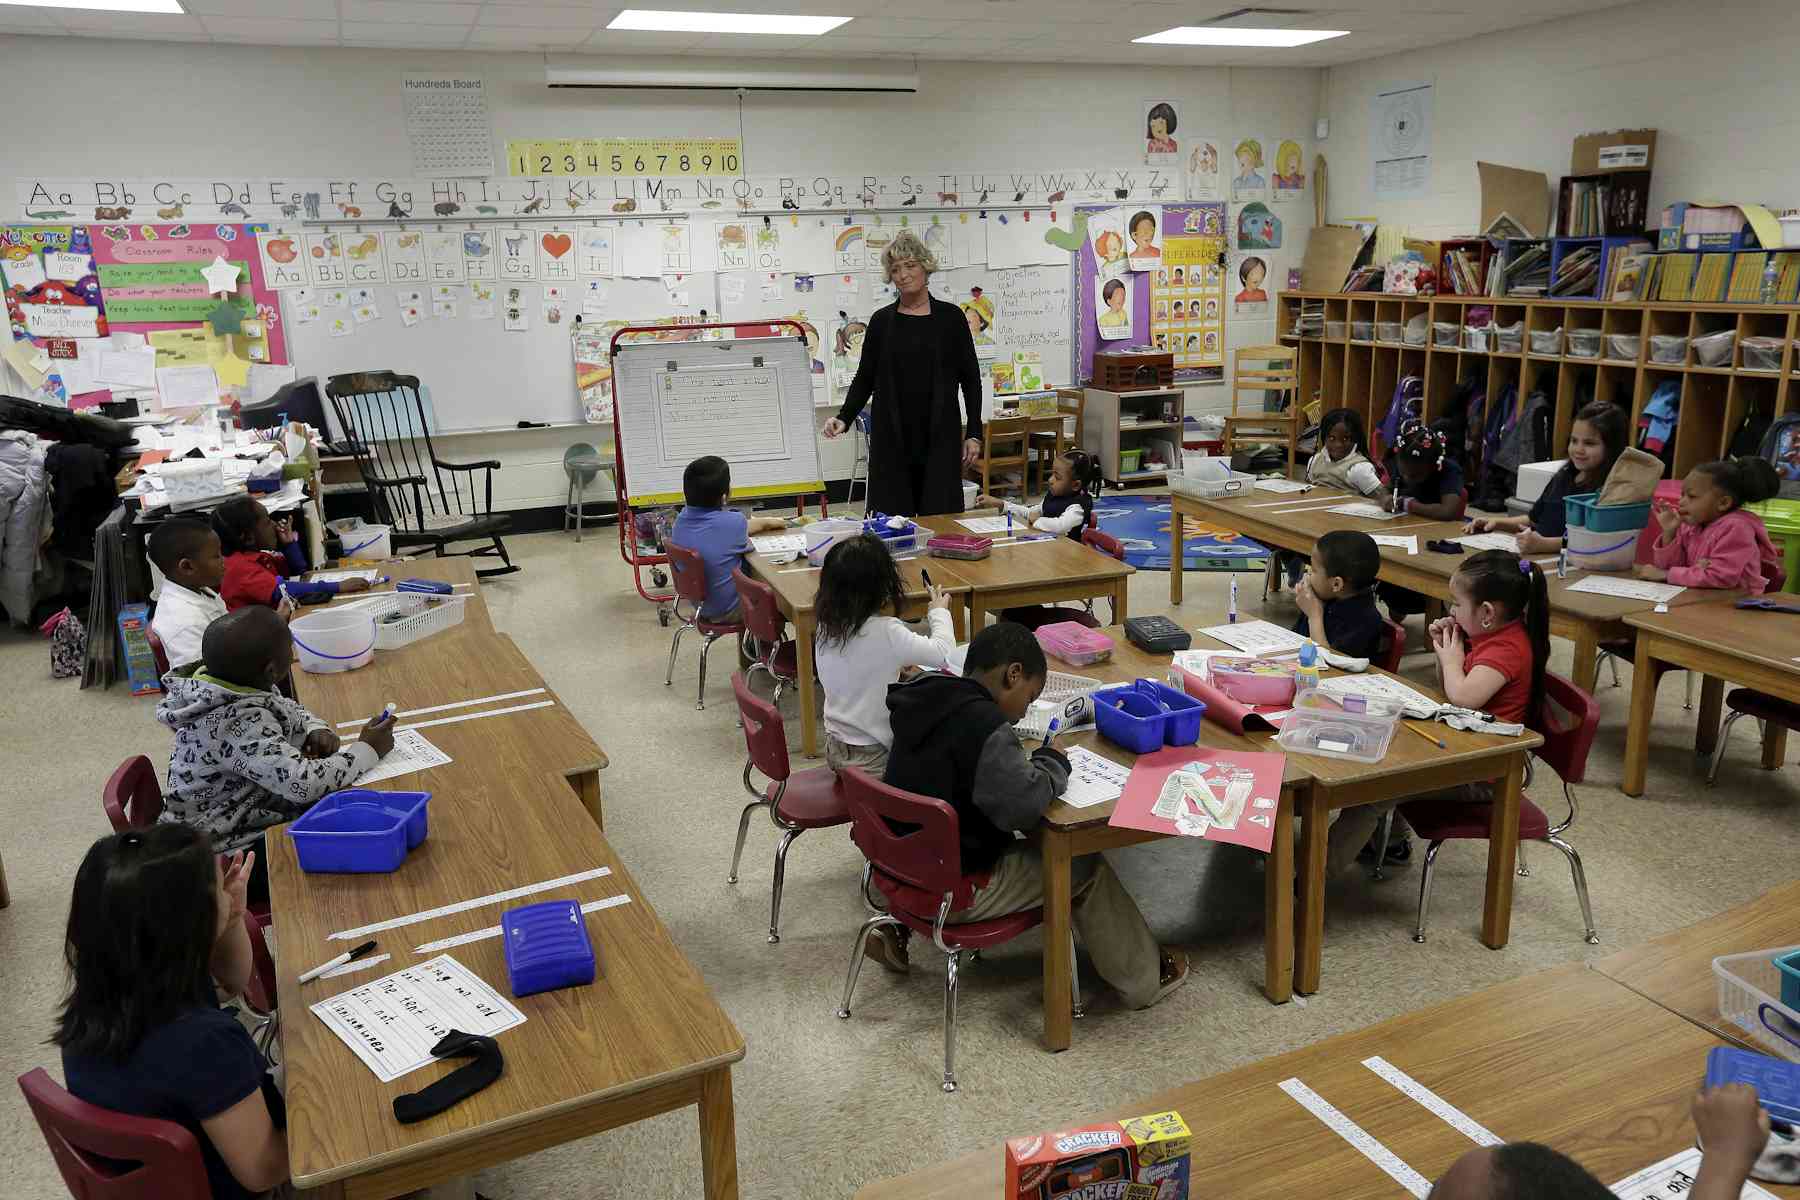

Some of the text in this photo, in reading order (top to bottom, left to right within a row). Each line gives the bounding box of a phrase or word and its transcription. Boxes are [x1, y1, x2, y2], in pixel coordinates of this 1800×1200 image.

[453, 79, 481, 89] Board
[519, 154, 738, 173] 1 2 3 4 5 6 7 8 9 10
[1055, 1131, 1120, 1152] CRACKER
